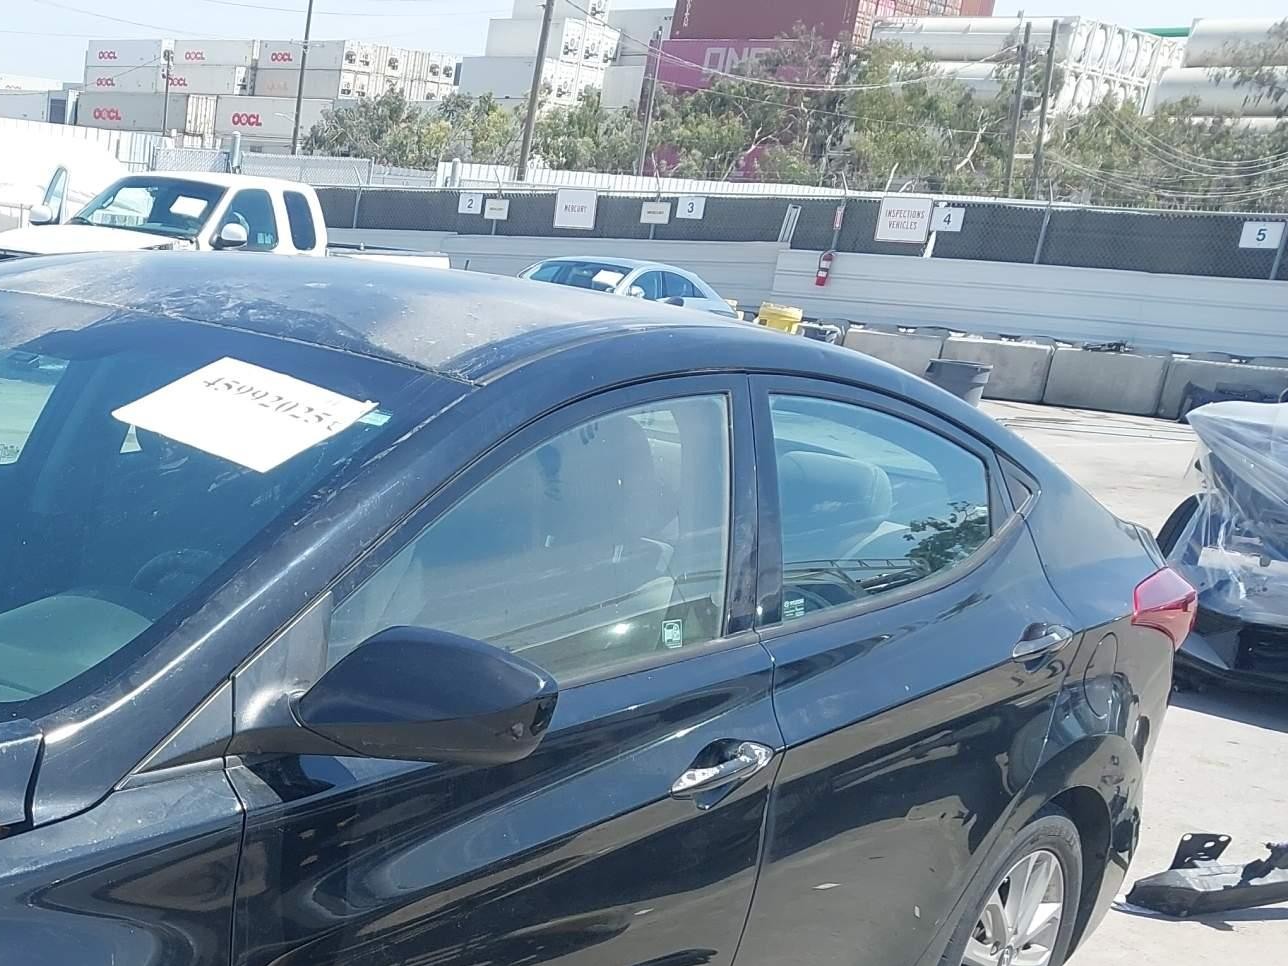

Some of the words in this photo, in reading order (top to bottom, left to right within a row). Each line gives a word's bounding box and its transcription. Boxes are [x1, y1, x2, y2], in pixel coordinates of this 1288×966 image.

[98, 50, 118, 60] OOCL
[184, 51, 205, 61] OOCL
[271, 52, 293, 62] OOCL
[96, 77, 115, 87] OOCL
[93, 107, 122, 121] OOCL
[232, 112, 262, 127] OOCL
[467, 198, 474, 209] 2
[687, 202, 695, 213] 3
[885, 208, 926, 220] INSPECTIONS
[943, 213, 952, 226] 4
[888, 220, 918, 231] VEHICLES
[1256, 228, 1267, 242] 5
